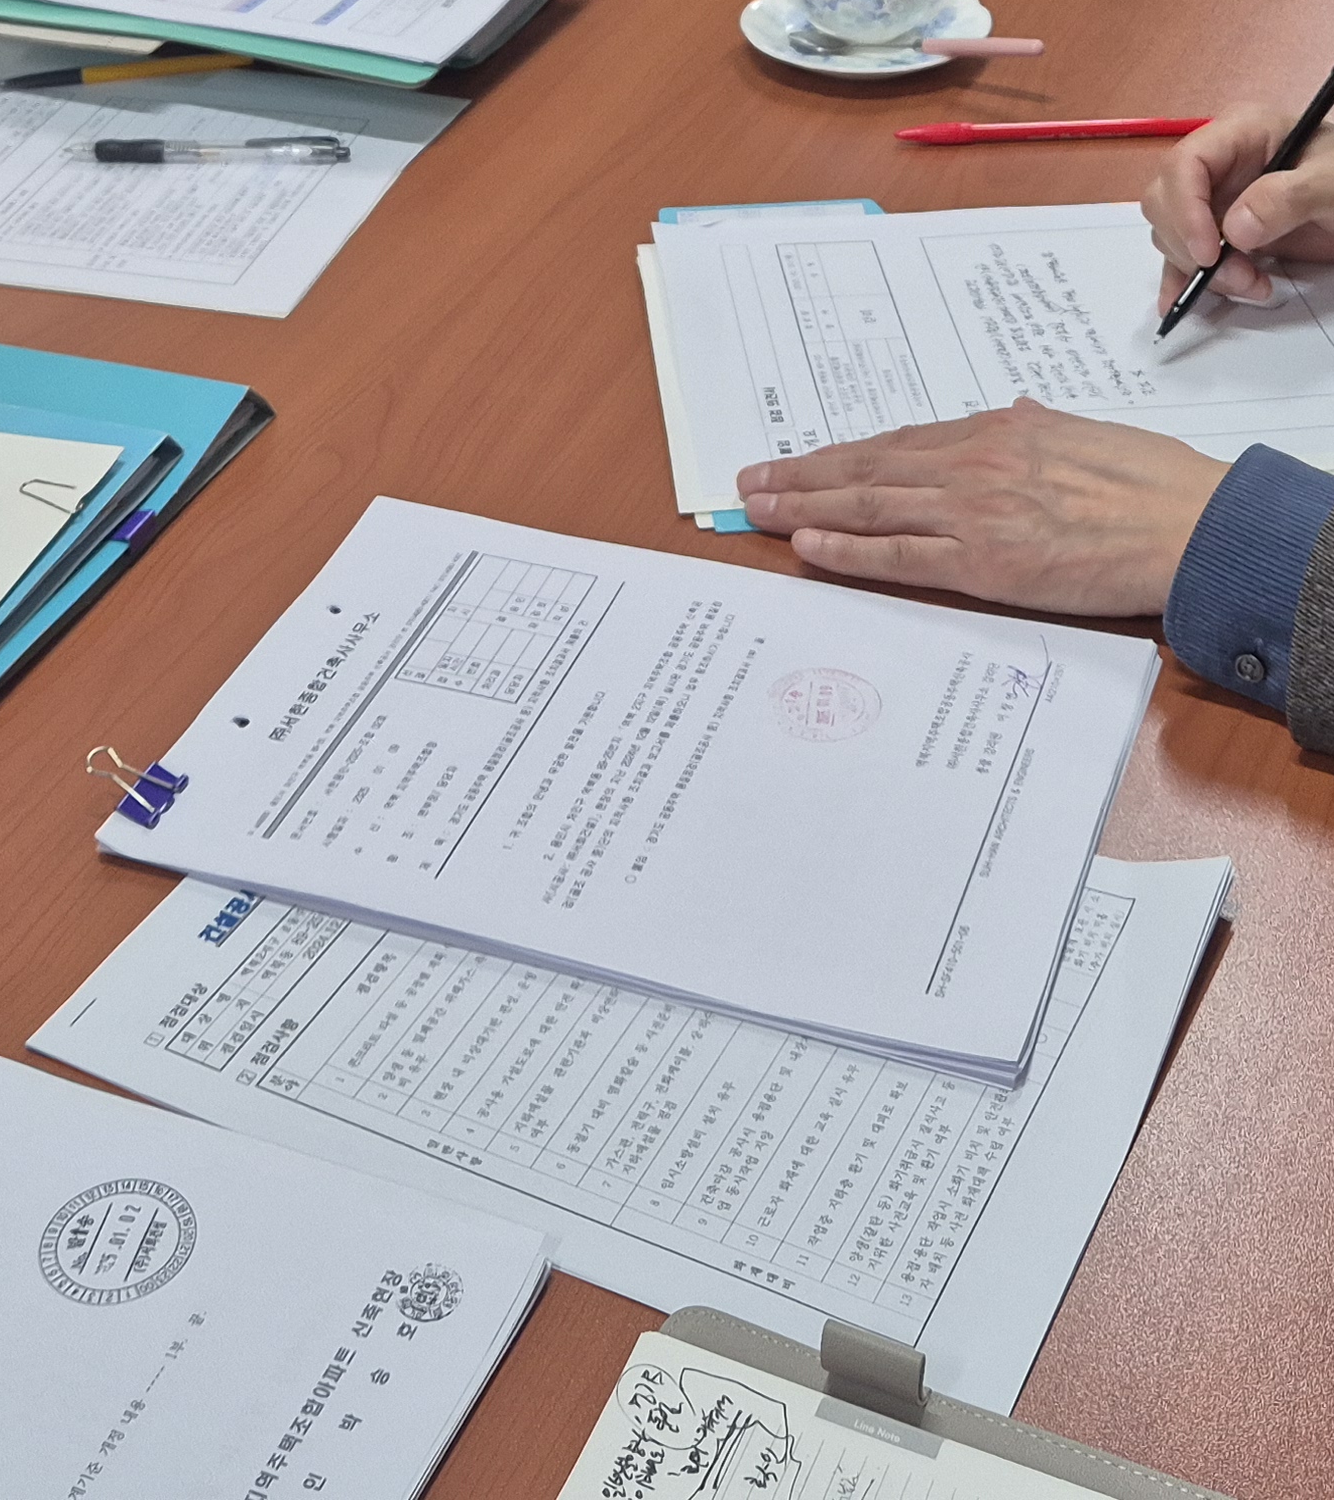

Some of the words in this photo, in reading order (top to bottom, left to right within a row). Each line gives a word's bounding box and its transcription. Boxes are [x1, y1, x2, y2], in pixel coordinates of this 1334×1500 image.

[355, 952, 397, 995] 점검항목
[159, 982, 208, 1028] 점검대상
[219, 1009, 265, 1054] 점검일시
[250, 1018, 299, 1066] 점검사항
[476, 1088, 505, 1120] 공사용
[501, 1037, 542, 1086] 가설도로에
[427, 1138, 484, 1166] 일반사항
[530, 1118, 550, 1139] 여부
[565, 1122, 596, 1154] 동절기
[590, 1098, 612, 1120] 대비
[622, 1124, 662, 1175] 지하매설물
[656, 1099, 678, 1120] 점검
[660, 1128, 707, 1189] 임시소방설비
[701, 1104, 723, 1125] 설치
[716, 1080, 737, 1102] 유무
[754, 1194, 785, 1228] 근로자
[778, 1159, 806, 1192] 화재에
[800, 1134, 821, 1156] 대한
[813, 1111, 835, 1133] 교육
[828, 1086, 849, 1108] 실시
[841, 1063, 861, 1084] 유무
[876, 1194, 895, 1212] 등)
[888, 1138, 925, 1191] 화기취급시
[918, 1095, 948, 1135] 질식사고
[716, 1199, 733, 1211] 업
[725, 1154, 760, 1196] 동시작업
[753, 1129, 775, 1152] 지양
[806, 1213, 834, 1247] 작업중
[827, 1178, 854, 1211] 지하층
[847, 1151, 869, 1175] 환기
[861, 1136, 878, 1150] 및
[871, 1103, 895, 1134] 대피로
[888, 1080, 909, 1100] 확보
[867, 1236, 895, 1271] 지위한
[887, 1189, 919, 1233] 사전교육
[911, 1173, 928, 1186] 및
[920, 1147, 941, 1171] 환기
[934, 1123, 953, 1145] 여부
[919, 1277, 935, 1292] 자
[927, 1251, 948, 1274] 배치
[938, 1235, 956, 1249] 등
[948, 1210, 970, 1233] 사전
[961, 1165, 992, 1208] 화재대책
[983, 1139, 1005, 1162] 수립
[997, 1116, 1016, 1137] 여부
[744, 1233, 760, 1247] 10
[795, 1253, 810, 1267] 11
[734, 1259, 797, 1290] 화재대비
[846, 1272, 862, 1287] 12
[898, 1292, 914, 1307] 13
[352, 1269, 403, 1338] 신축현장
[98, 1428, 126, 1457] 개정
[120, 1398, 147, 1425] 내용
[164, 1338, 189, 1360] 1부.
[187, 1310, 208, 1327] 끝.
[302, 1471, 328, 1492] 인
[338, 1413, 364, 1432] 박
[370, 1367, 391, 1386] 승
[396, 1320, 419, 1342] 호
[854, 1417, 875, 1435] Line
[877, 1425, 901, 1445] Note
